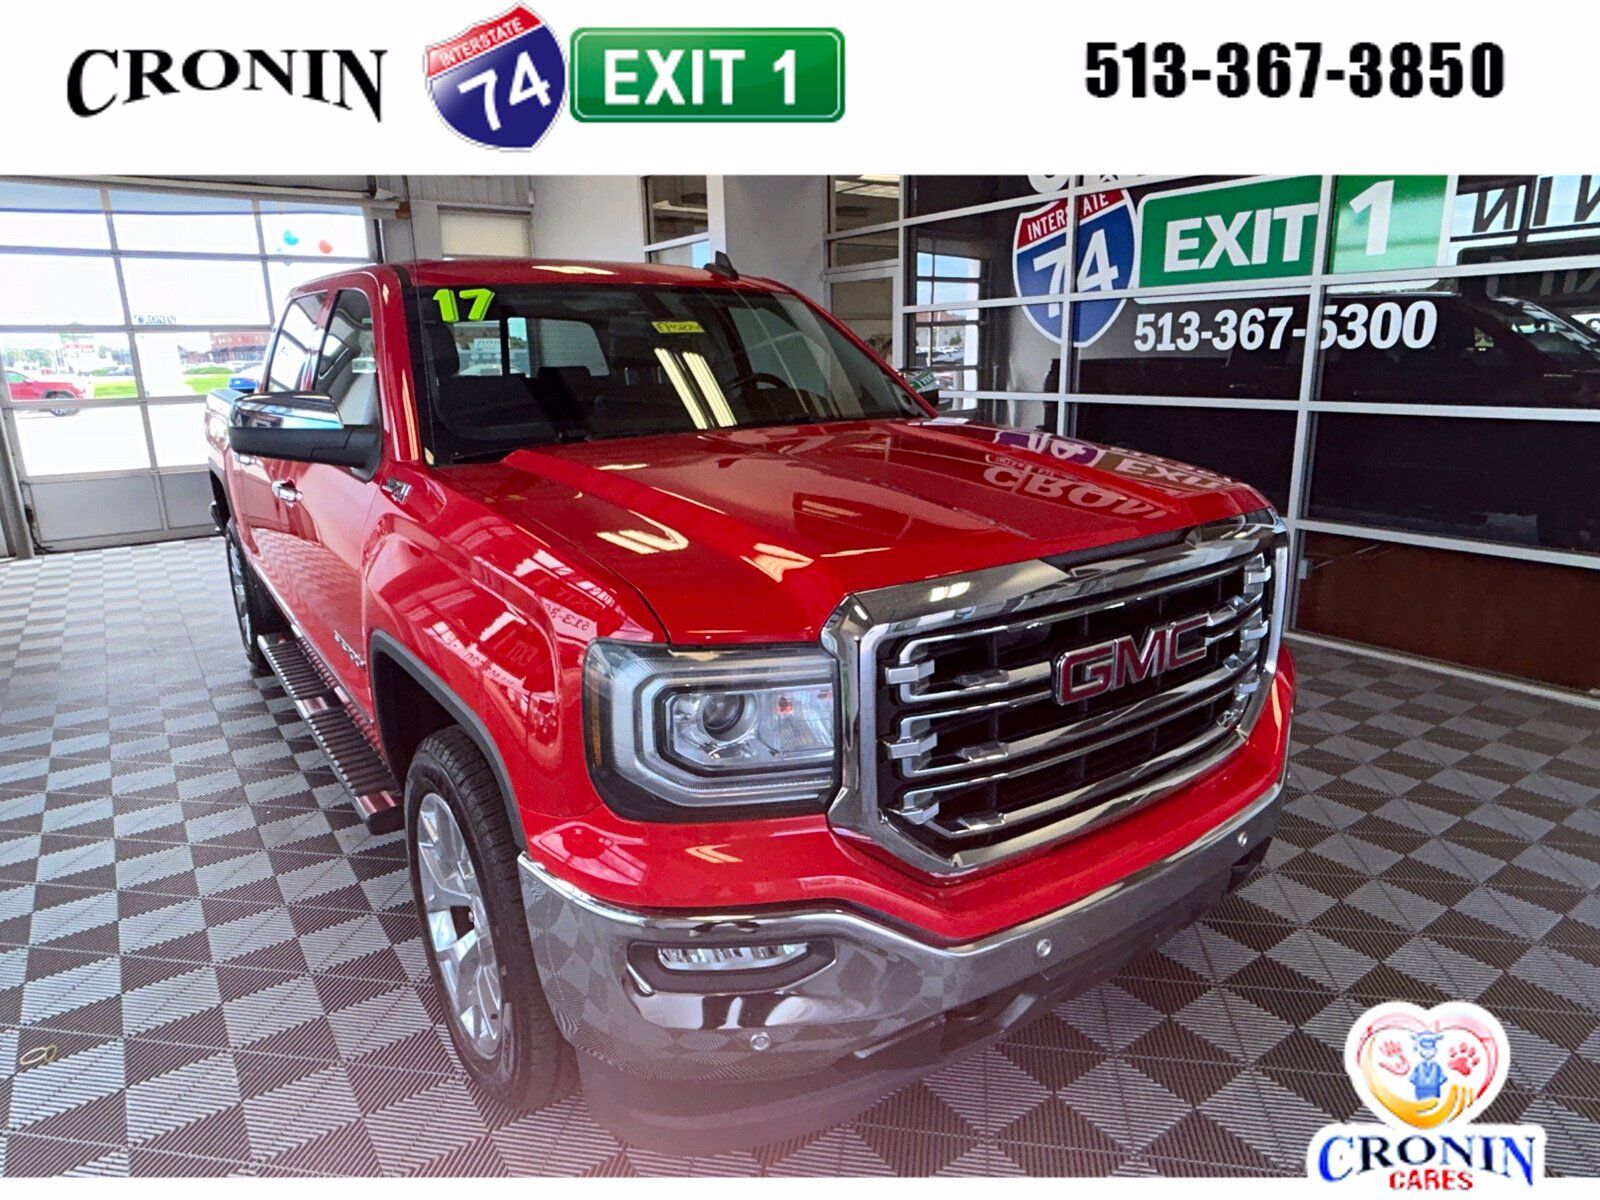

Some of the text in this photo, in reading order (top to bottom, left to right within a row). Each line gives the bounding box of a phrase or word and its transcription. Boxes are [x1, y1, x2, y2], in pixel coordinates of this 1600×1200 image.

[1163, 178, 1395, 274] EXIT 1
[433, 288, 496, 322] 17
[1033, 228, 1119, 319] 74
[1134, 299, 1438, 352] 513-367-5300
[1056, 613, 1213, 706] GMC
